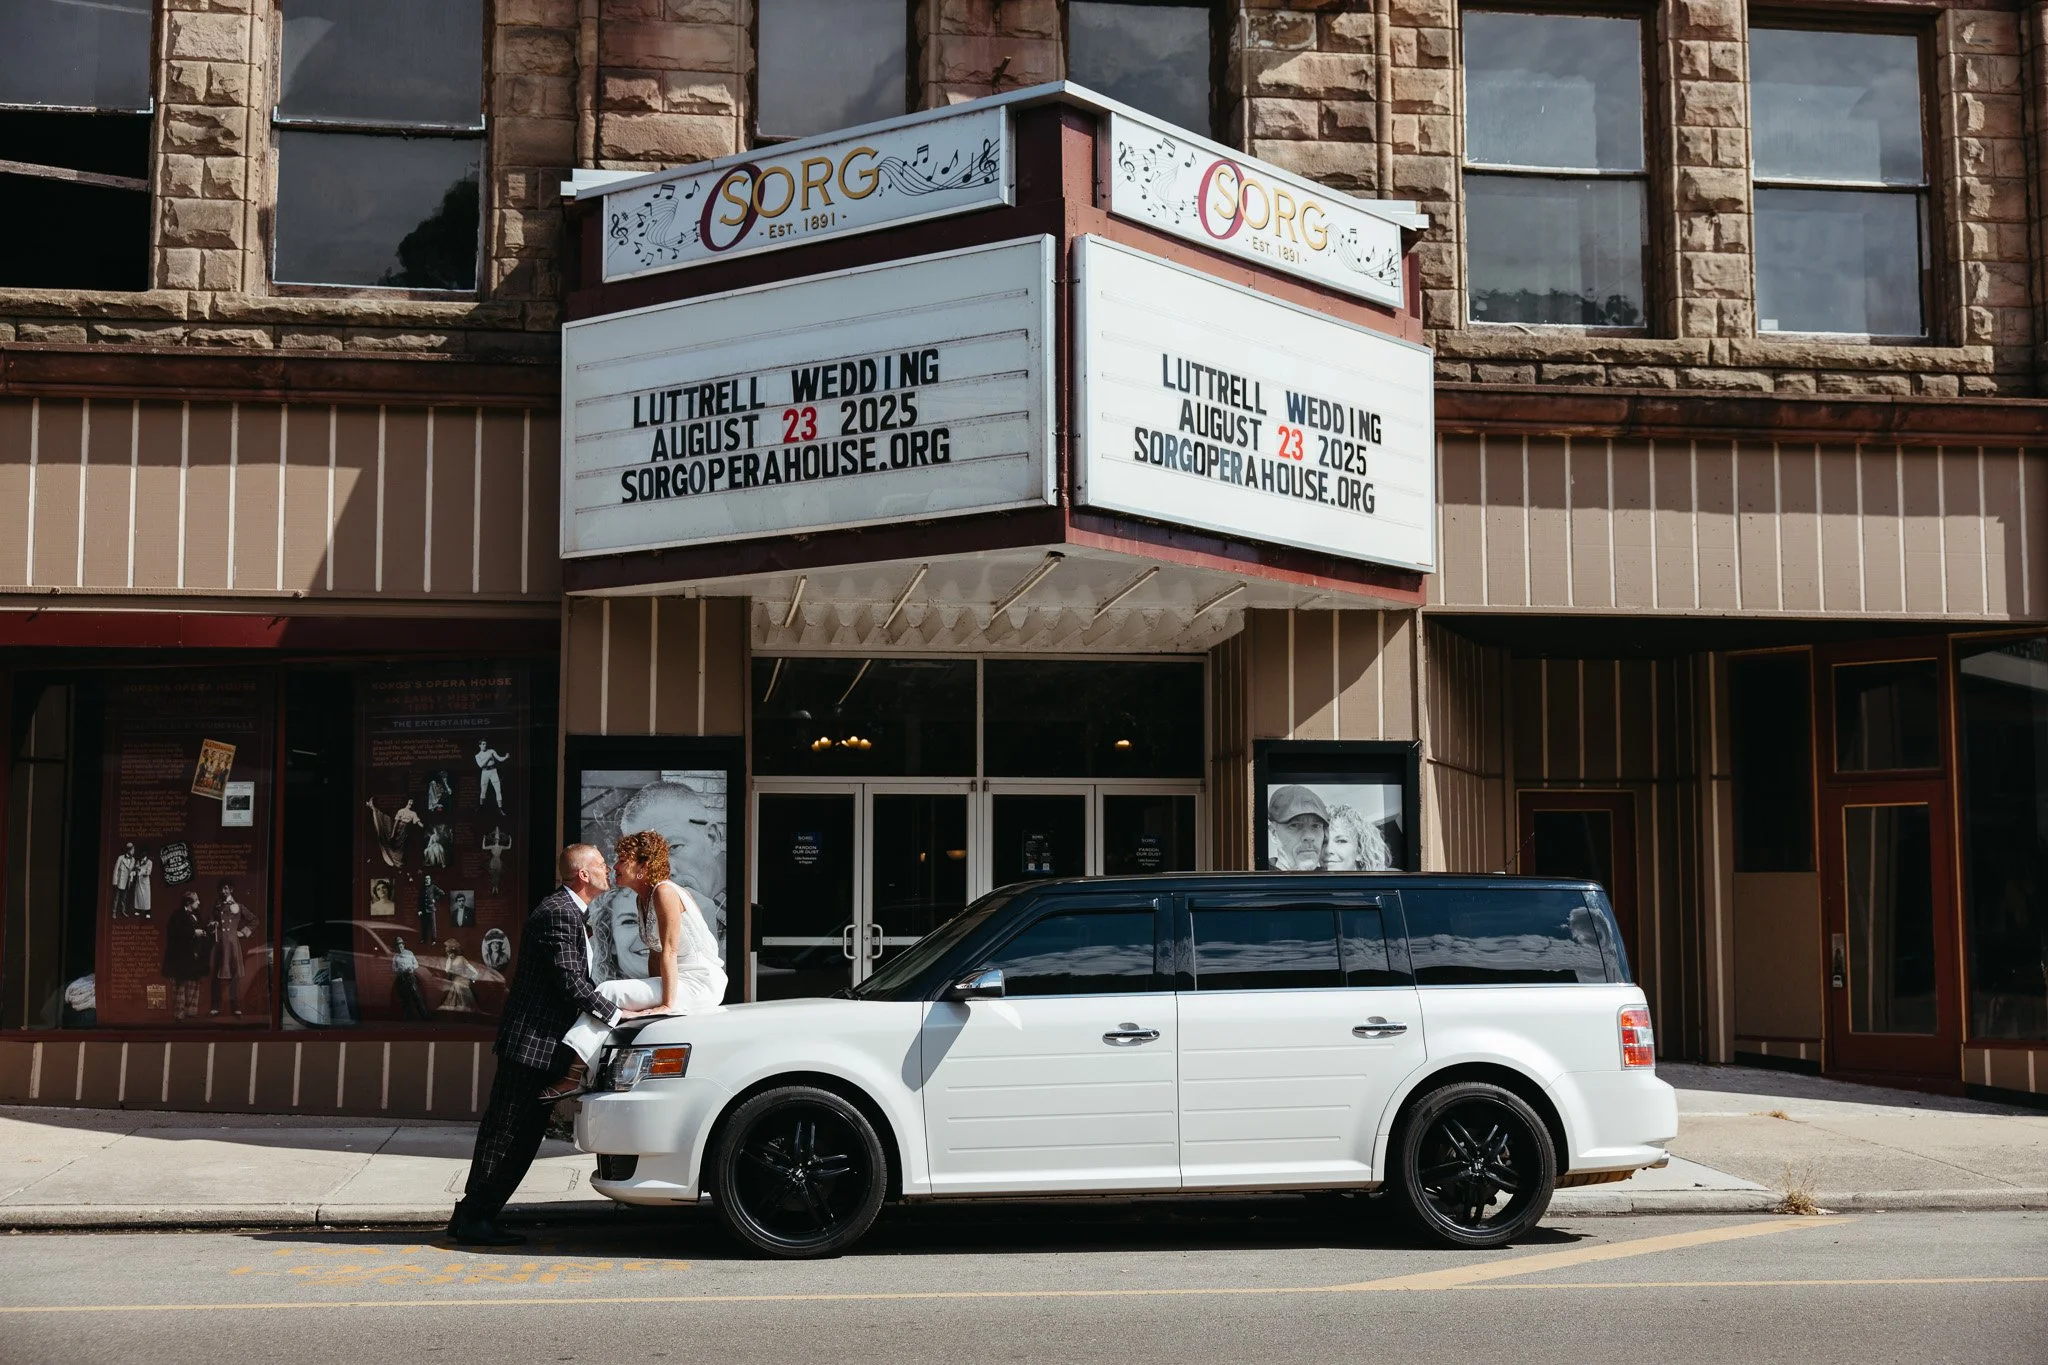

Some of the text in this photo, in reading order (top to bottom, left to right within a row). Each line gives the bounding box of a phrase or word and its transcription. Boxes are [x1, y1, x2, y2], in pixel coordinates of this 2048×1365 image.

[719, 146, 880, 226] SORG
[804, 212, 836, 231] 1891
[1213, 166, 1328, 251] SORG
[1277, 245, 1301, 264] 1891
[633, 348, 939, 428] LUTTRELL WEDDING
[1162, 353, 1382, 445] LUTTRELL WEDDING
[621, 427, 951, 504] SORGOPERAHOUSE.ORG
[650, 392, 918, 463] AUGUST 23 2025
[1179, 398, 1367, 476] AUGUST 23 2025
[1134, 426, 1375, 514] SORGOPERAHOUSE.ORG
[426, 679, 466, 689] OPERA
[470, 677, 513, 687] HOUSE
[392, 718, 492, 729] THE ENTERTAINERS
